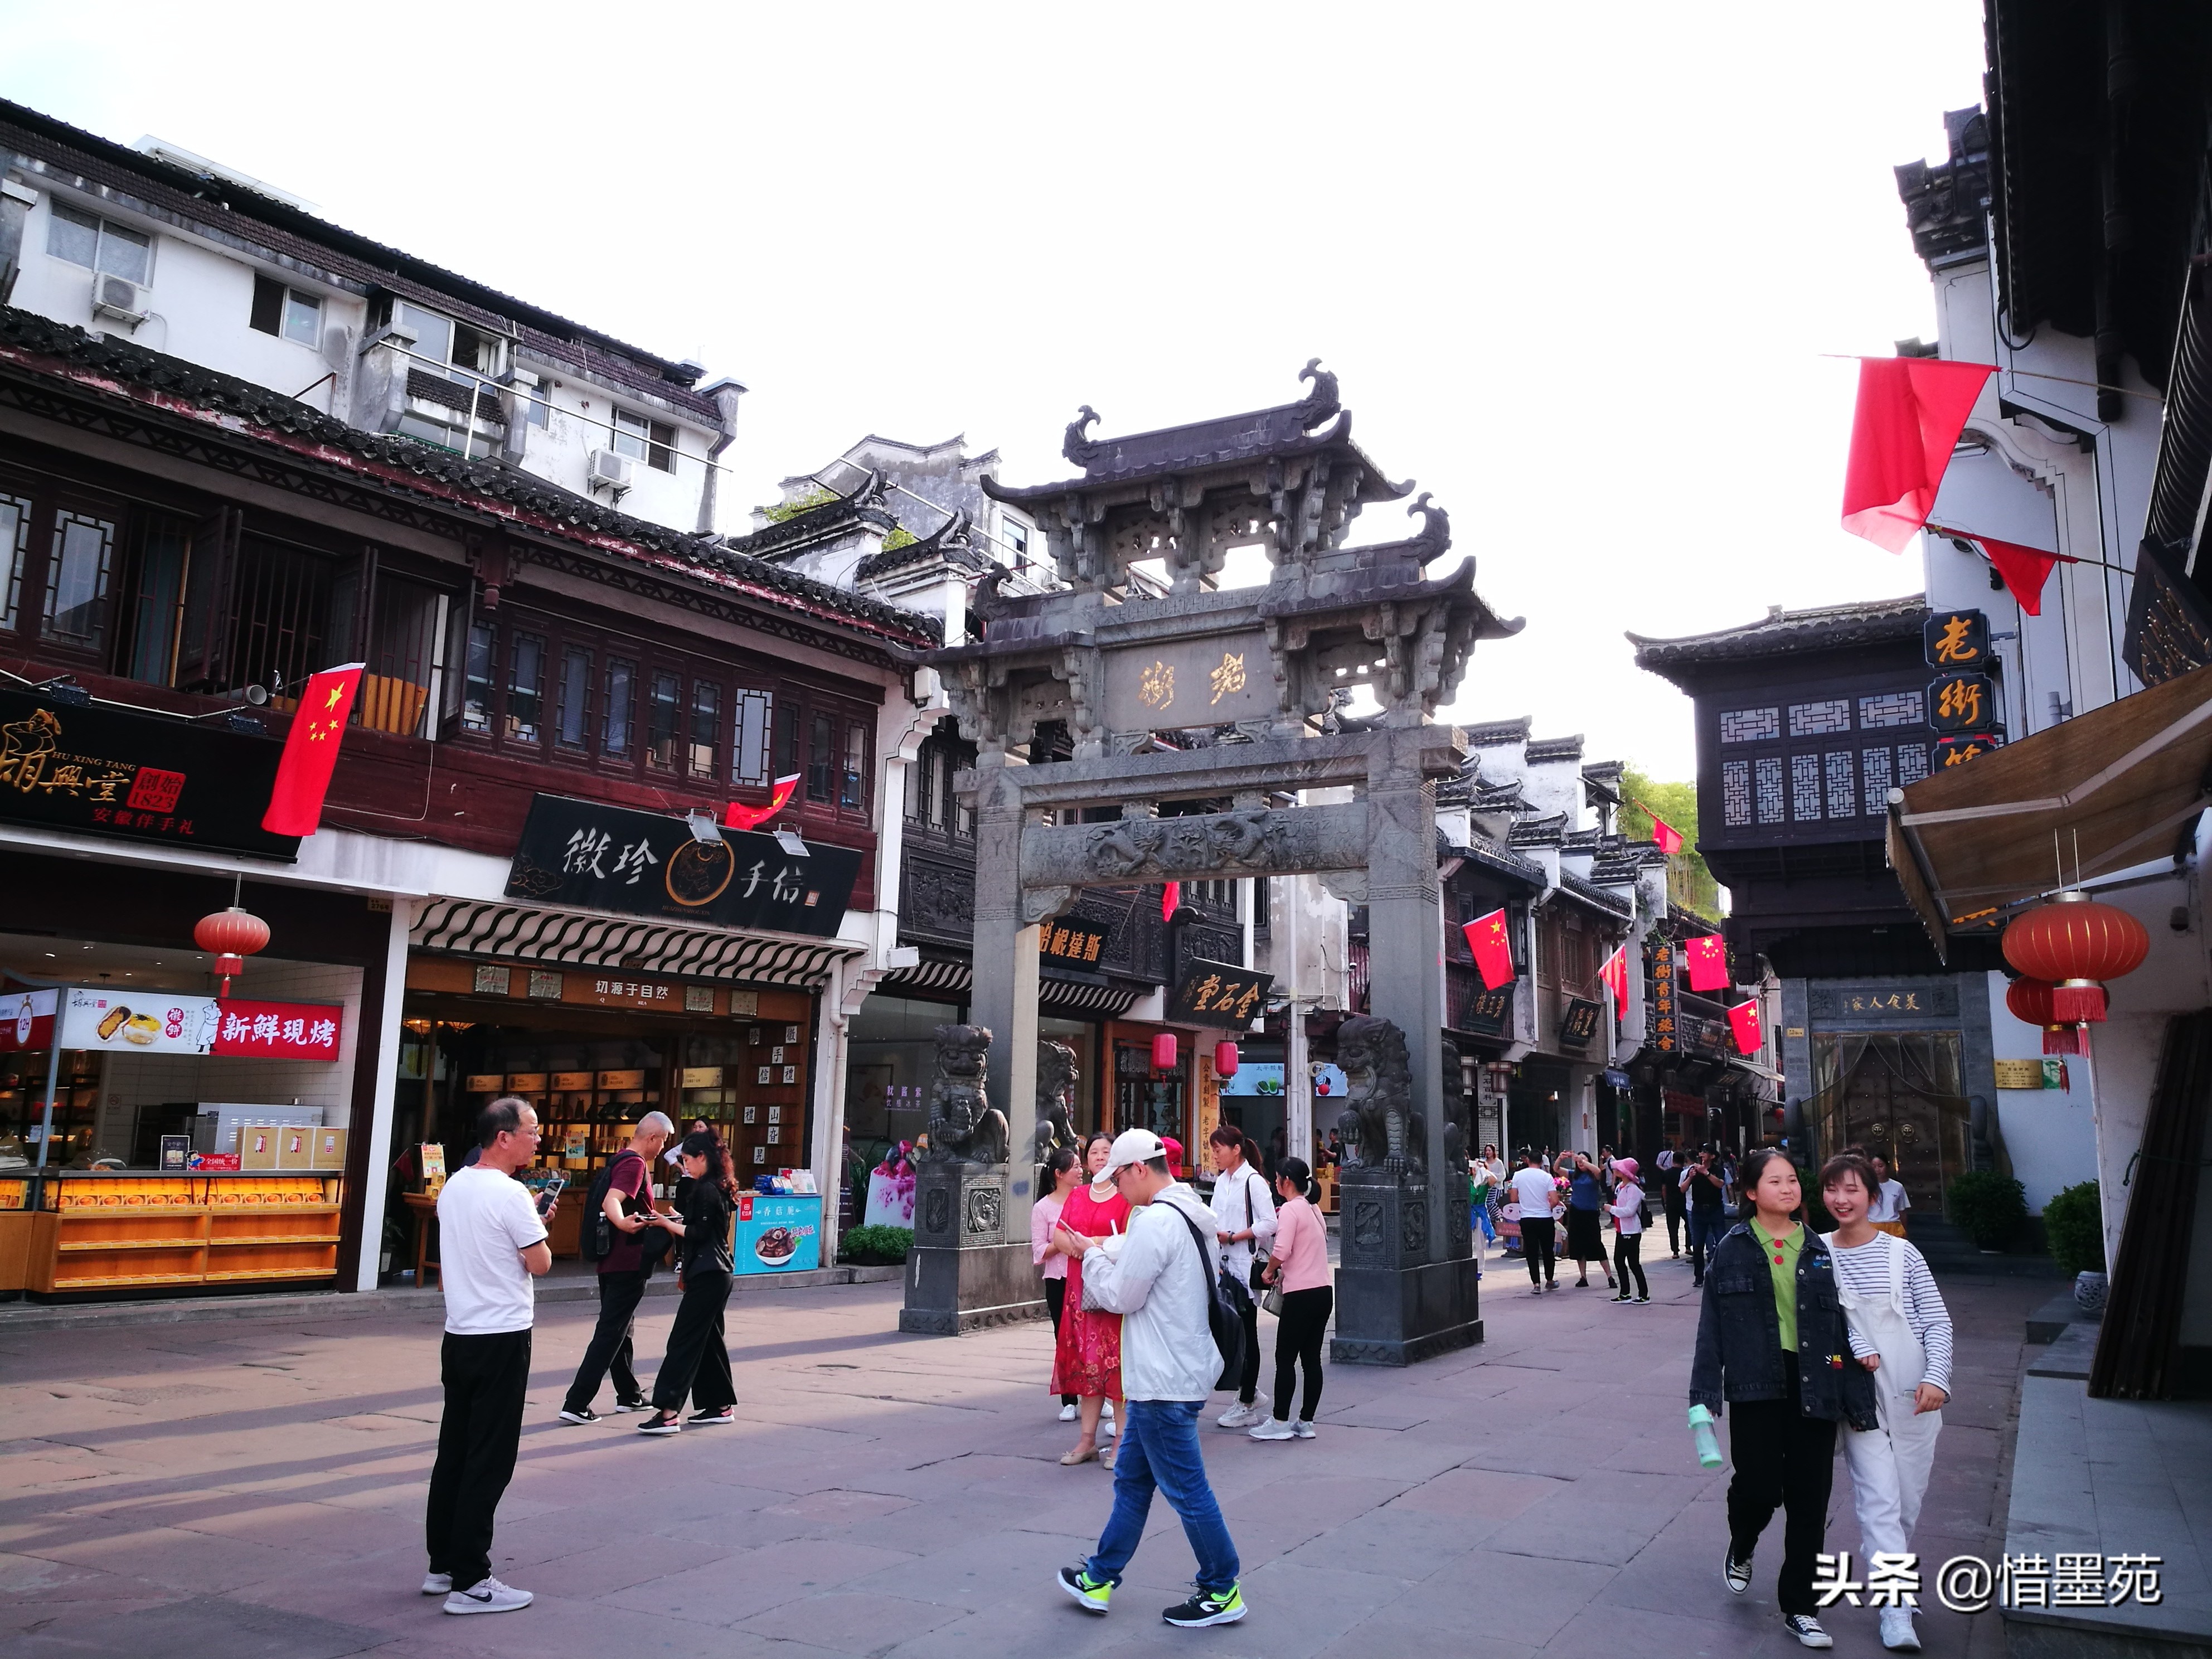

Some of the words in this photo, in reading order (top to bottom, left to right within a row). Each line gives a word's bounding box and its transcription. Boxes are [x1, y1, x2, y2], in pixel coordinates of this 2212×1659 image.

[1137, 652, 1246, 710] 老街
[52, 752, 69, 760] HU
[73, 755, 102, 766] XING
[106, 760, 136, 772] TANG
[137, 772, 182, 795] 創始
[132, 793, 175, 809] 1823
[91, 808, 195, 835] 安徽伴手礼
[563, 827, 658, 885] 徽珍
[740, 860, 803, 904] 手信
[1194, 974, 1259, 1018] 金石堂
[1655, 947, 1675, 1050] 老街青年旅舍
[1852, 993, 1920, 1011] 美食人家
[20, 1017, 31, 1031] 12H
[222, 1011, 336, 1048] 新鮮現烤
[773, 1049, 782, 1062] 手
[760, 1069, 769, 1081] 信
[770, 1109, 778, 1120] 山
